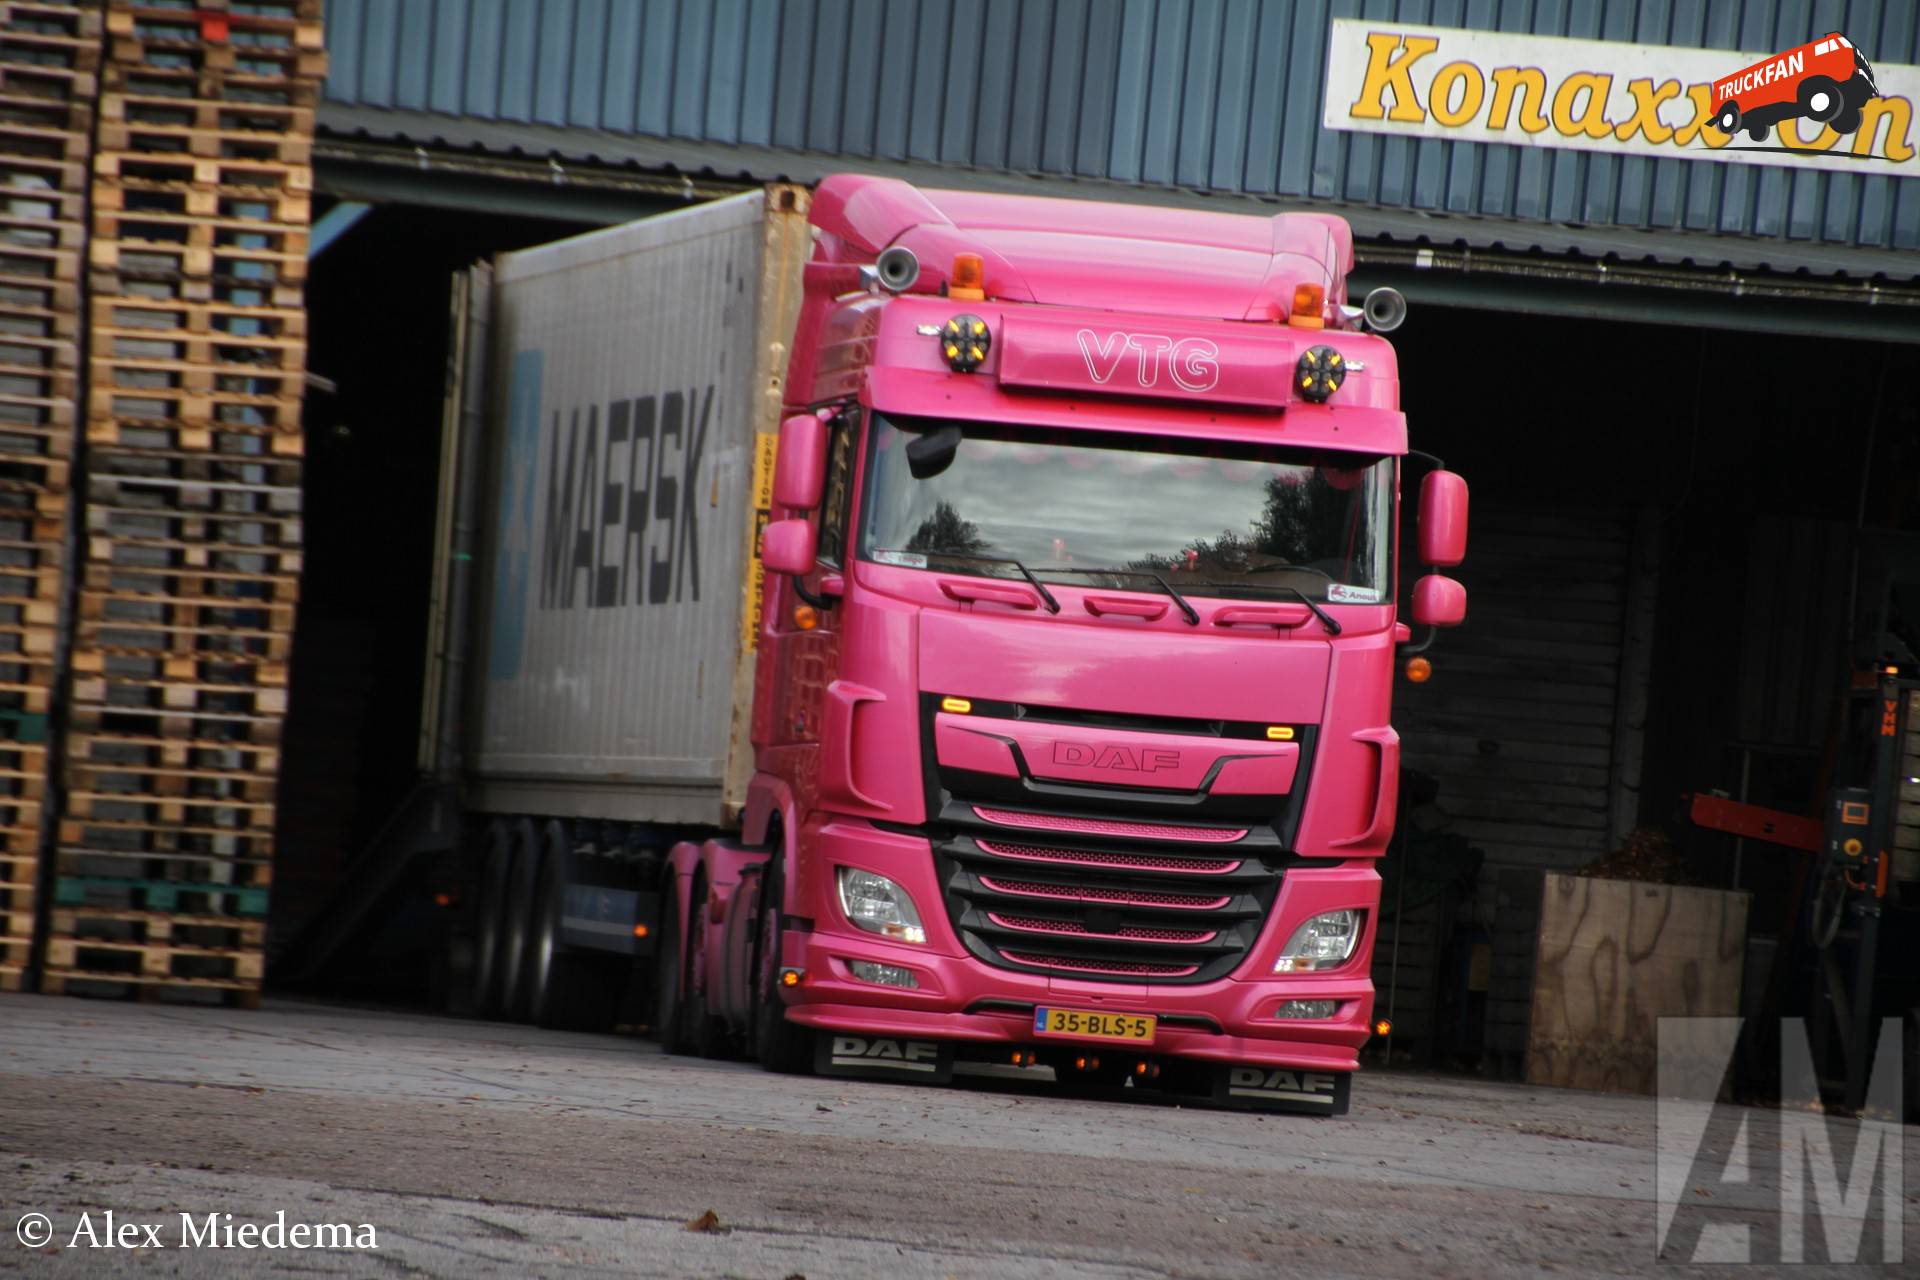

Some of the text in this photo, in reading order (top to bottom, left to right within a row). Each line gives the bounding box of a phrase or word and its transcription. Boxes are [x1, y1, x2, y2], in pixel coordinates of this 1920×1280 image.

[1076, 328, 1219, 393] VTG
[539, 384, 715, 610] MAERSK
[1052, 741, 1181, 773] DAF
[1053, 1012, 1147, 1038] 35-BLS-5
[832, 1036, 938, 1061] DAF
[1229, 1067, 1335, 1092] DAF
